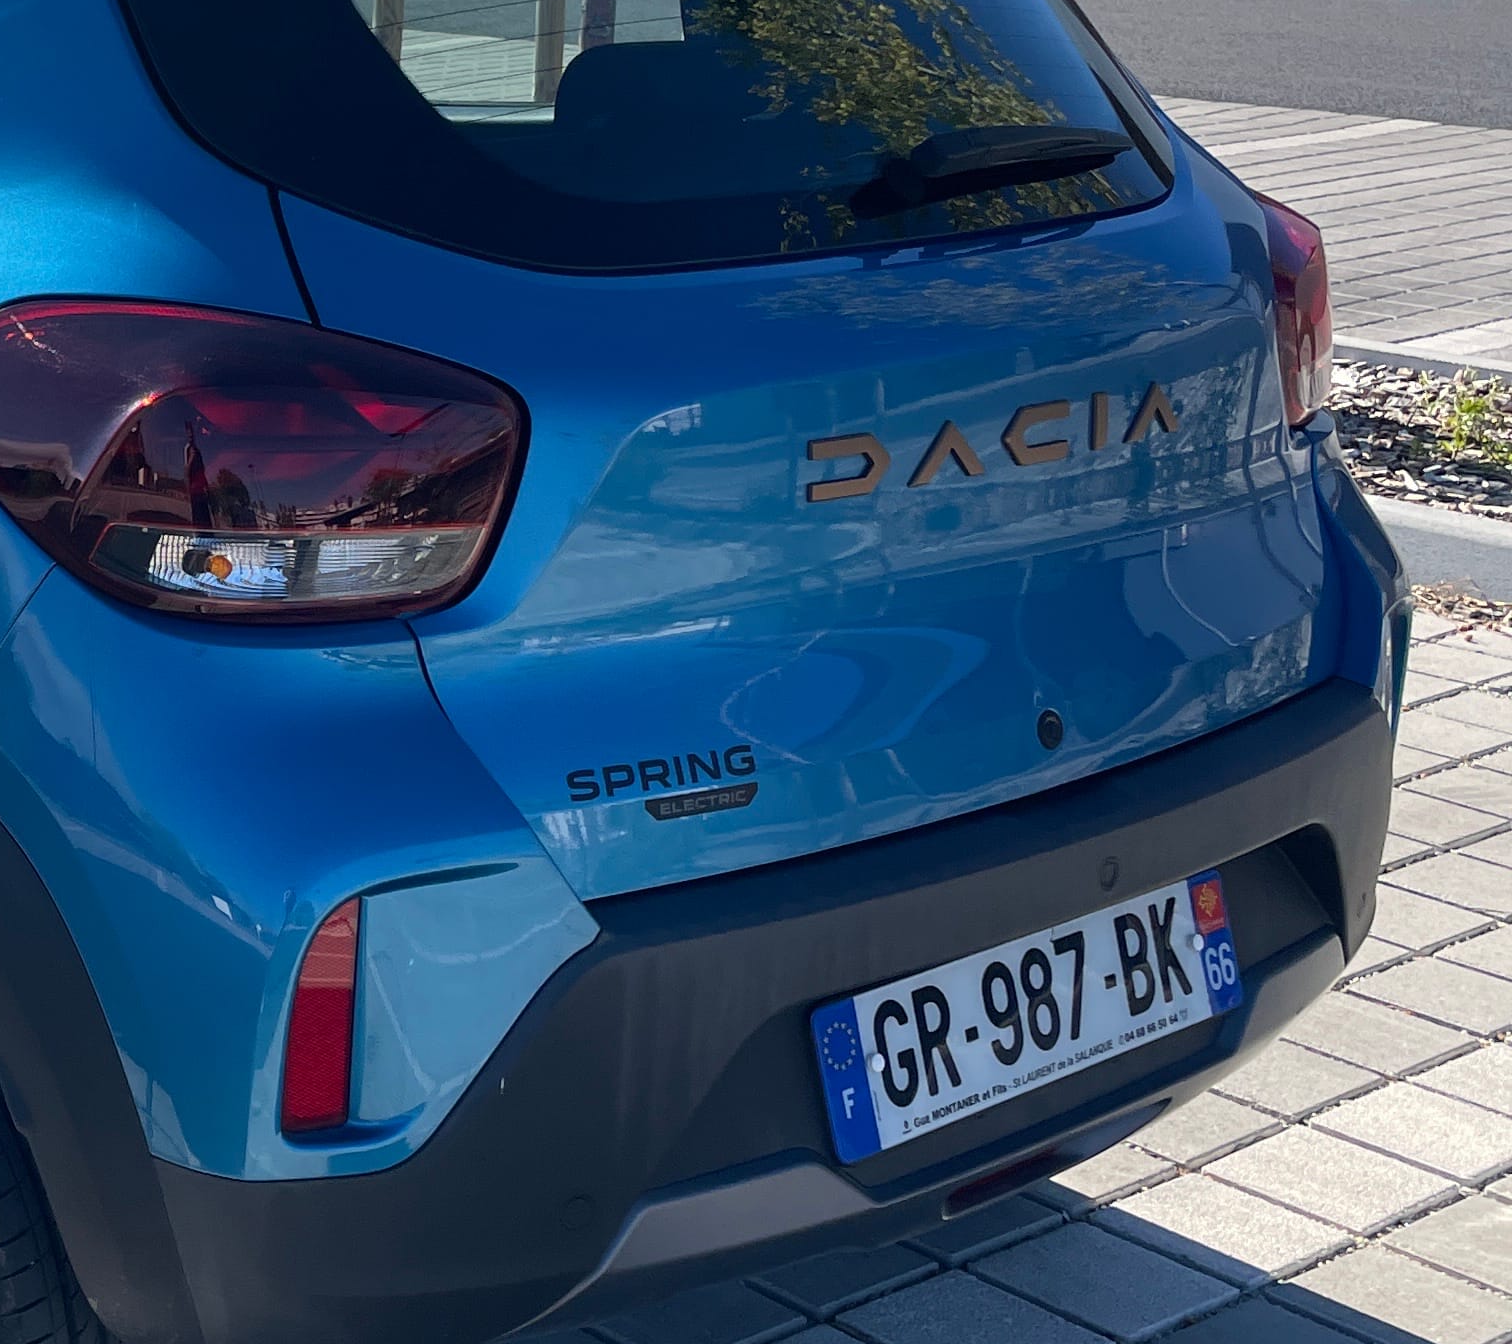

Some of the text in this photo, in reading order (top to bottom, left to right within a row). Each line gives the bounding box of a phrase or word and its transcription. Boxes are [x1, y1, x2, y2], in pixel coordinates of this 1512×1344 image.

[807, 381, 1180, 503] DACIA
[566, 744, 757, 802] SPRING
[659, 789, 748, 816] ELECTRIC
[840, 896, 1236, 1120] F GR-987-BK 66
[931, 1093, 981, 1120] MONTANER
